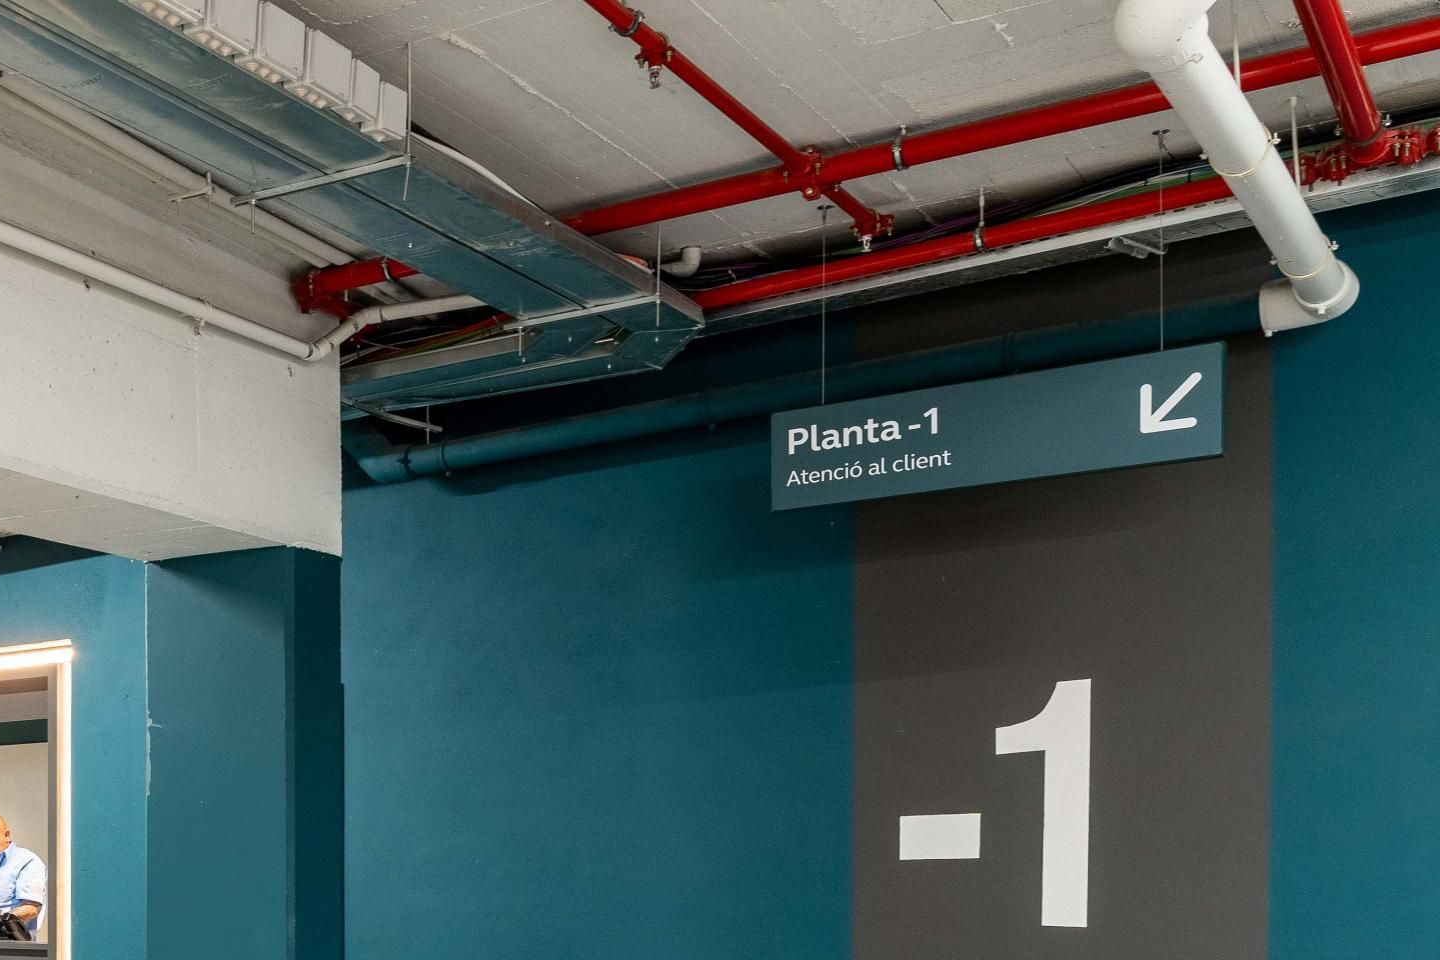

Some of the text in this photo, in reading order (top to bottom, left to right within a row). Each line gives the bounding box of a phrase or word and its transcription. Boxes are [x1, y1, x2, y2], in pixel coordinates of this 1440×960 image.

[788, 407, 939, 455] Planta -1
[786, 450, 952, 487] Atenció al client
[898, 678, 1092, 928] -1
